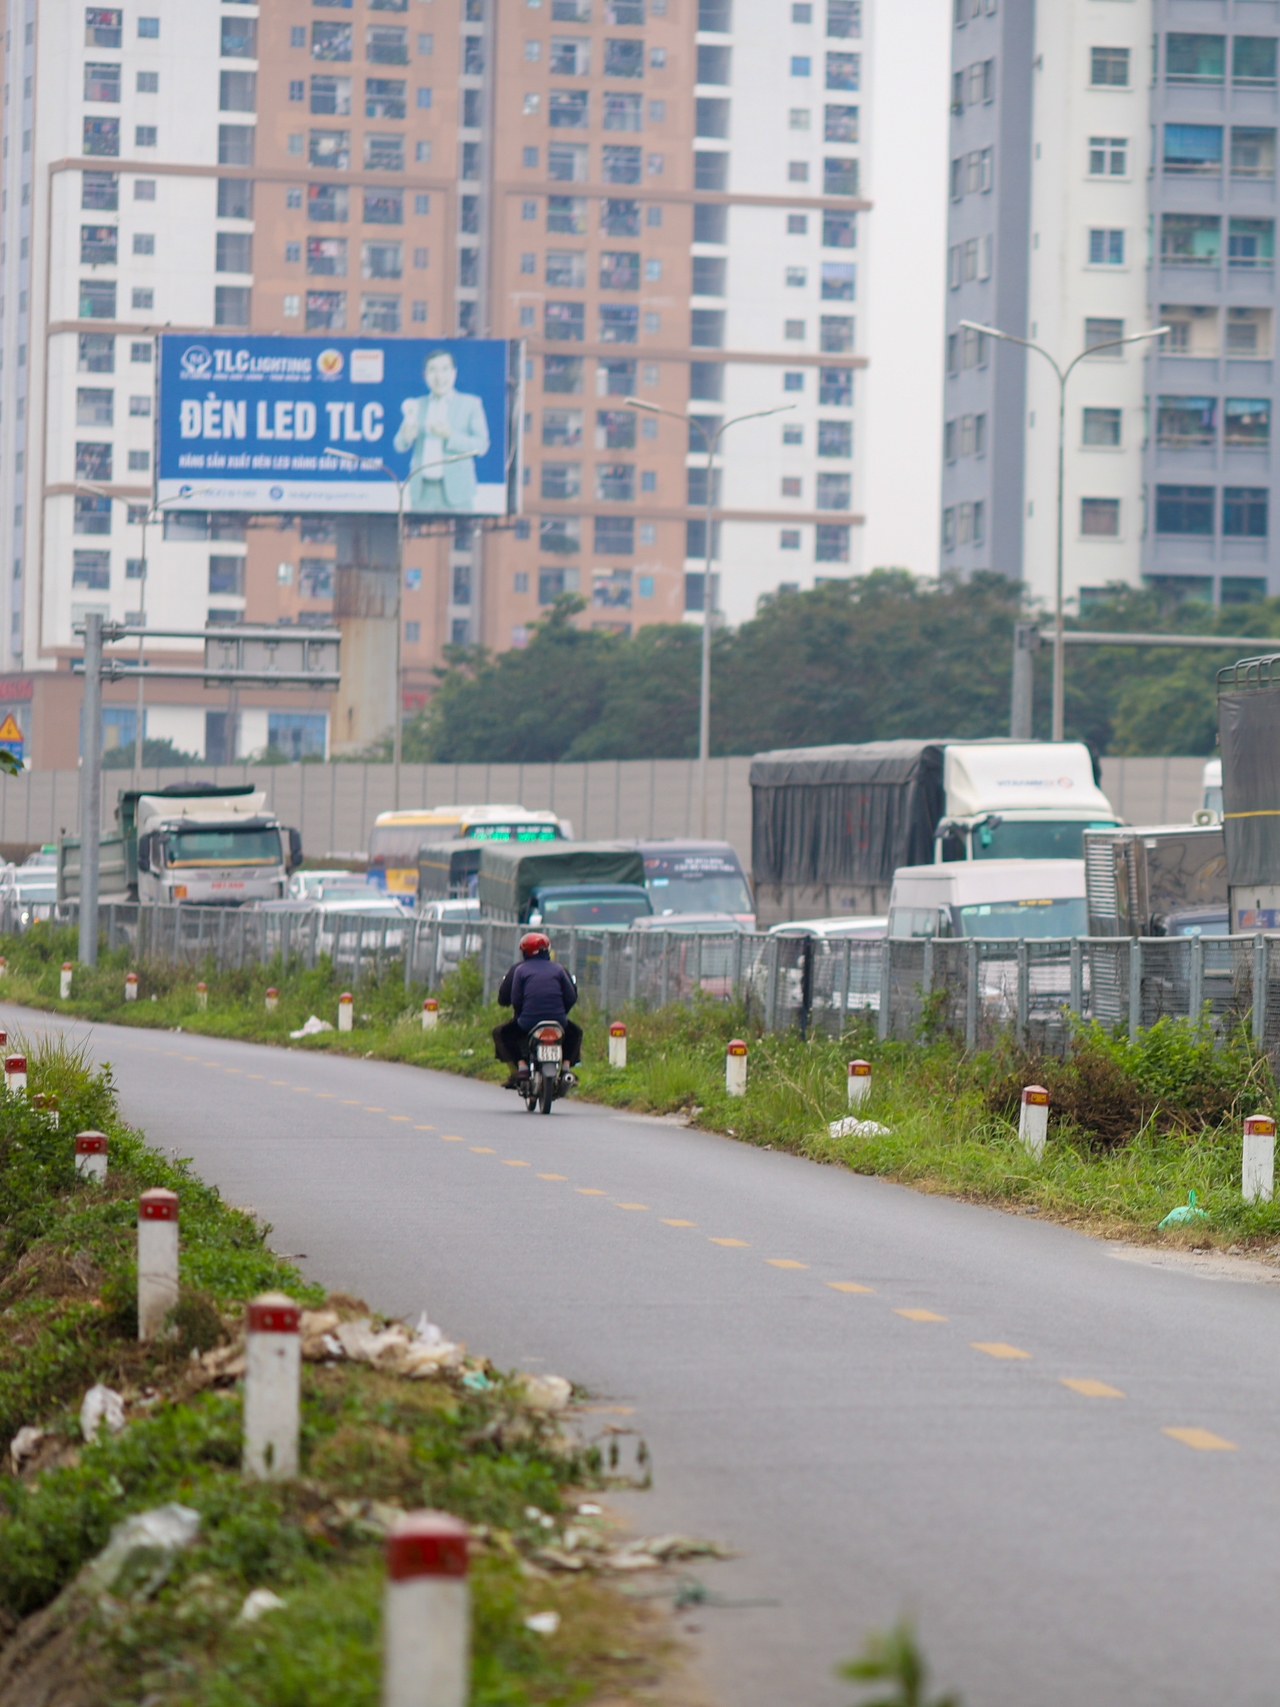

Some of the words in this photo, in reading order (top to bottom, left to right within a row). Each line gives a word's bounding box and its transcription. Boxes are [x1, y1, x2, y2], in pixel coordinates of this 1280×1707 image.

[213, 349, 250, 373] TLC
[250, 356, 312, 373] LIGHTING
[179, 391, 247, 440] ĐÈN
[256, 400, 317, 441] LED
[325, 402, 384, 442] TLC
